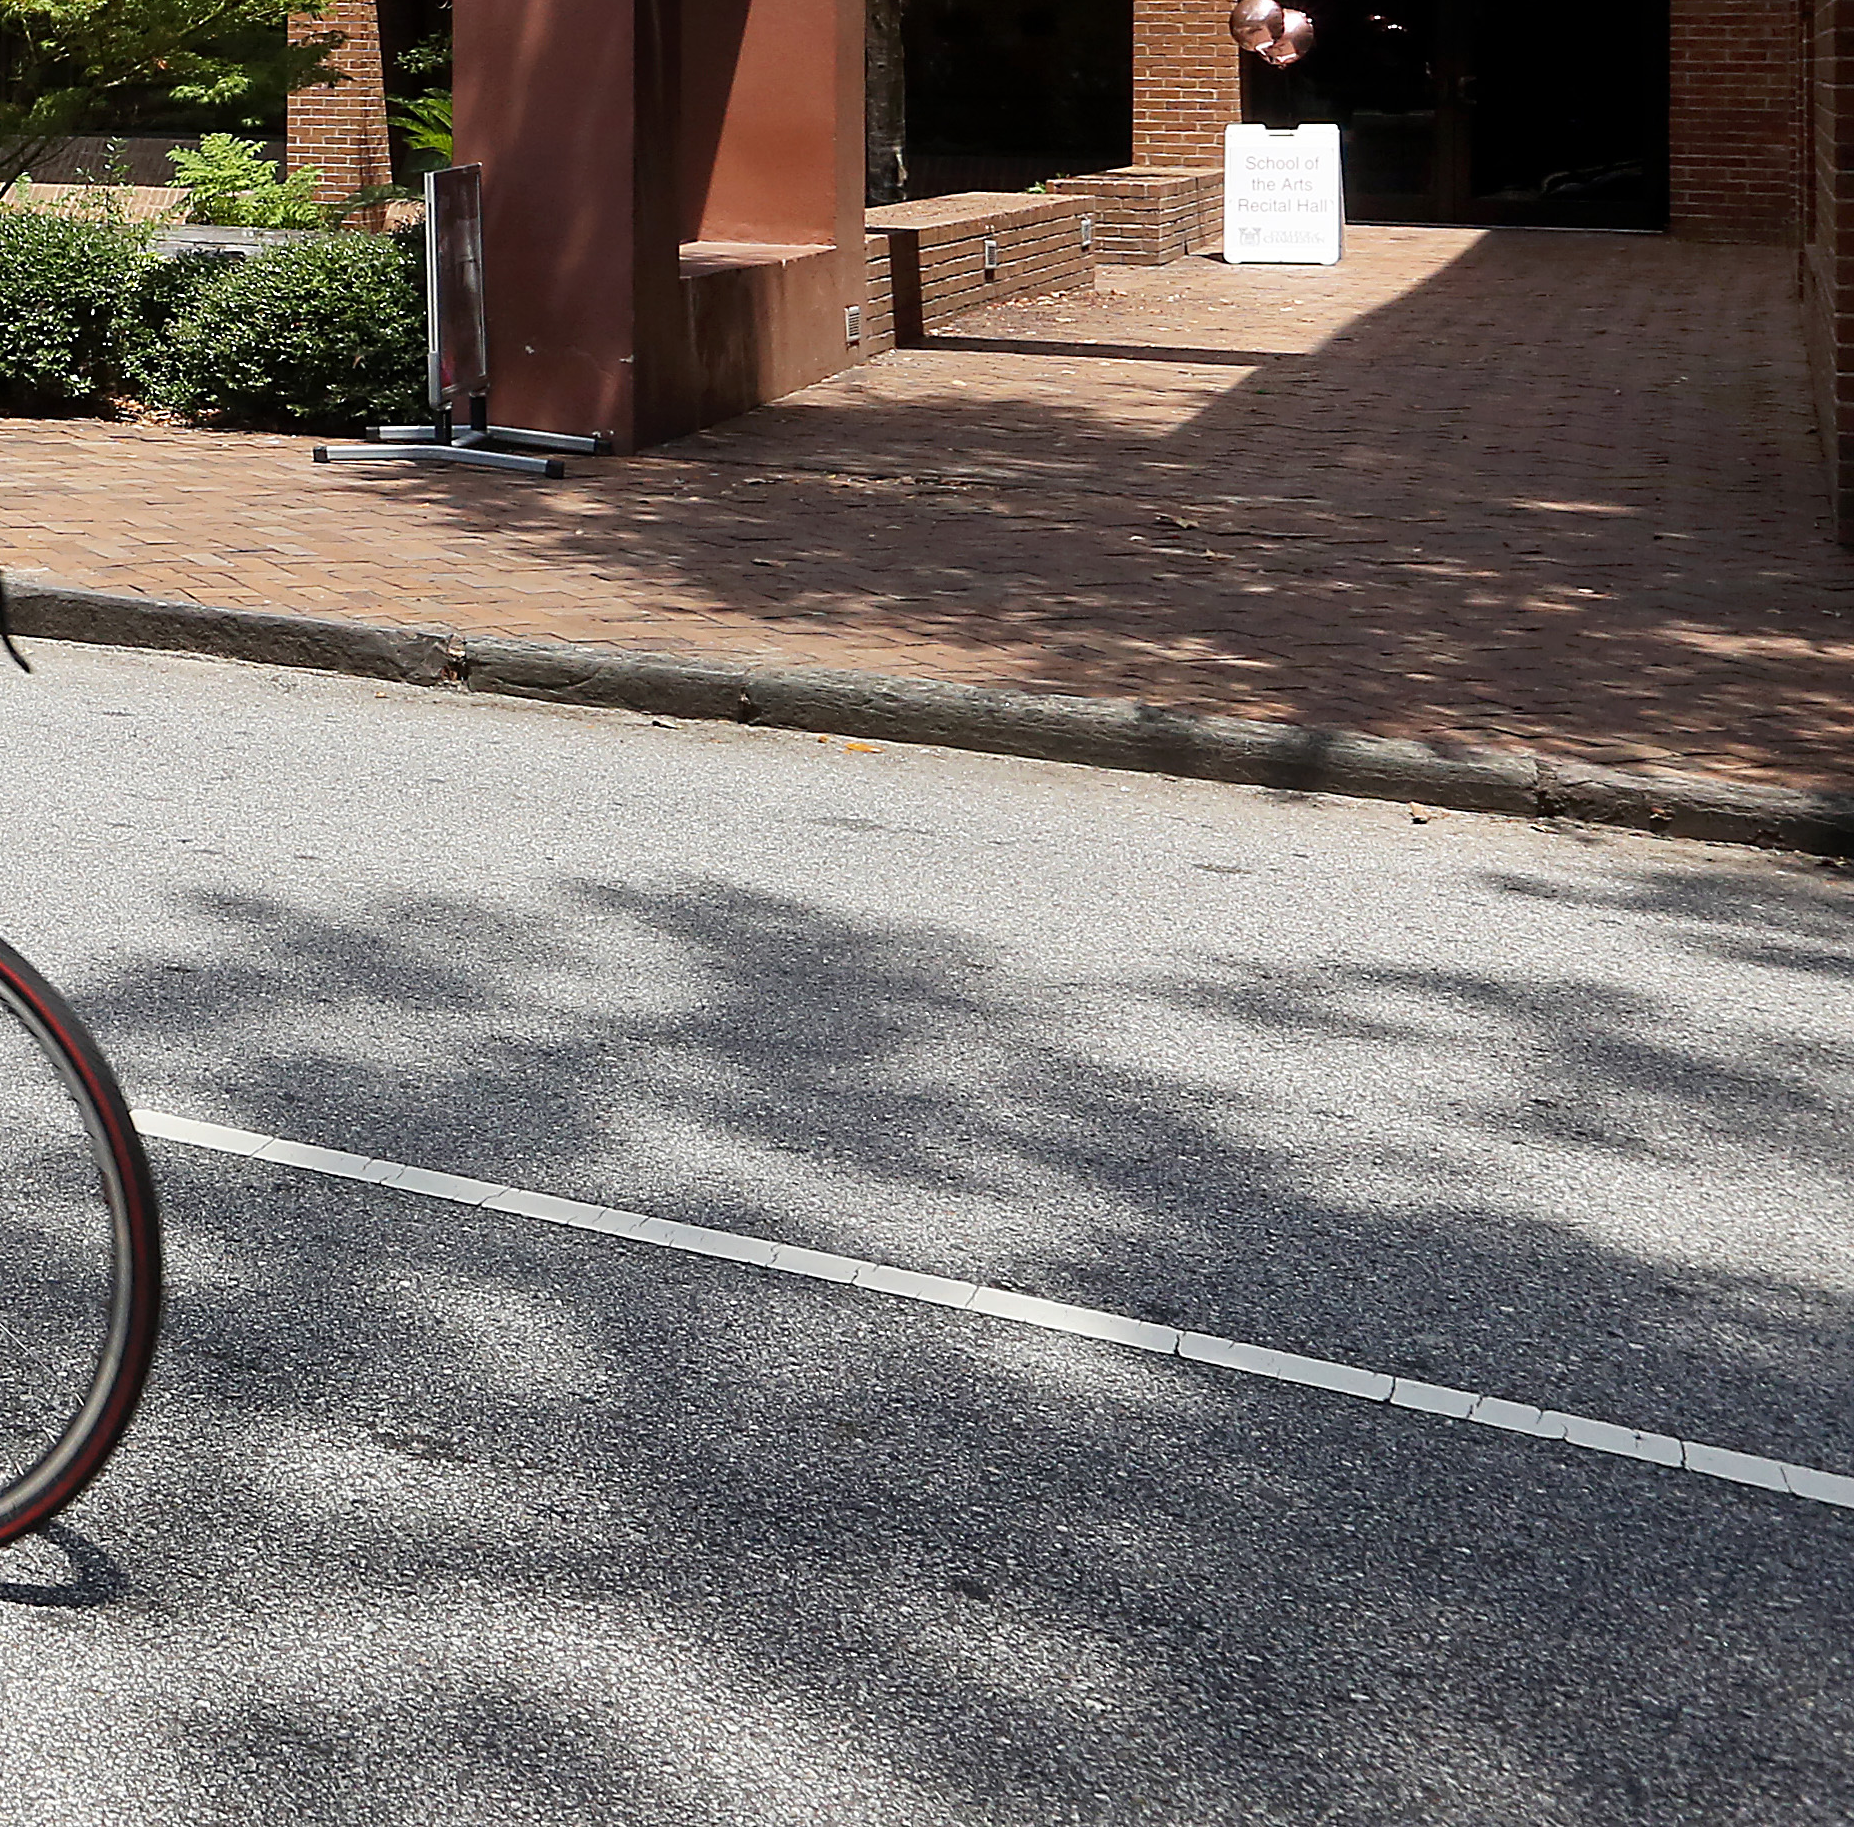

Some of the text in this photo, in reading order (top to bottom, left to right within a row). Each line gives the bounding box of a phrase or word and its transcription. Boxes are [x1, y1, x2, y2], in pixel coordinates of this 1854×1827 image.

[1245, 156, 1319, 170] School of
[1252, 178, 1313, 191] the Arts
[1238, 198, 1328, 212] Recital Hall
